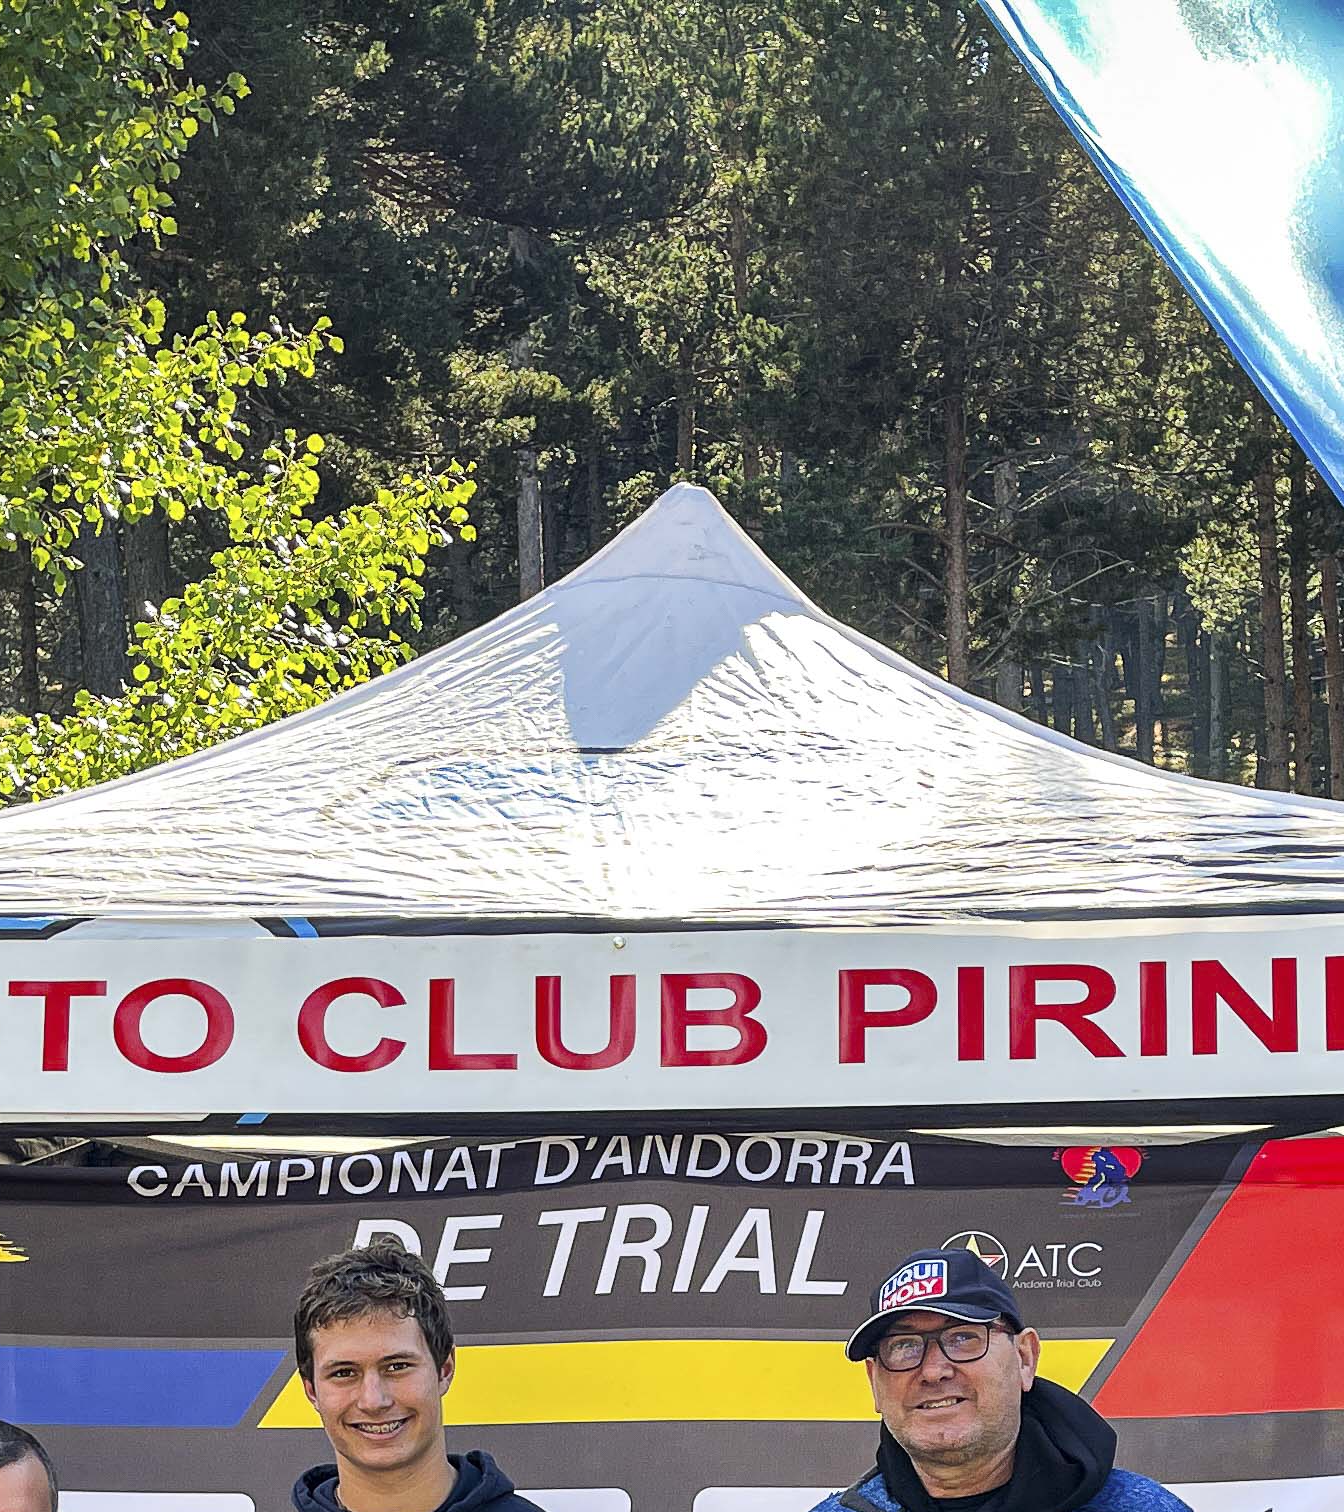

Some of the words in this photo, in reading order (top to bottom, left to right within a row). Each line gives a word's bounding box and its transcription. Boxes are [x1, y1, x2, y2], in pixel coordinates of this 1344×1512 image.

[296, 970, 769, 1074] CLUB
[127, 1144, 503, 1198] CAMPIONAT
[533, 1134, 916, 1186] D'ANDORRA
[536, 1205, 851, 1297] TRIAL
[1014, 1243, 1103, 1278] ATC
[883, 1280, 938, 1310] MOLY
[884, 1264, 939, 1297] LIQUI
[1012, 1279, 1054, 1289] Andorra
[1056, 1278, 1075, 1288] Trial
[1077, 1278, 1102, 1289] Club
